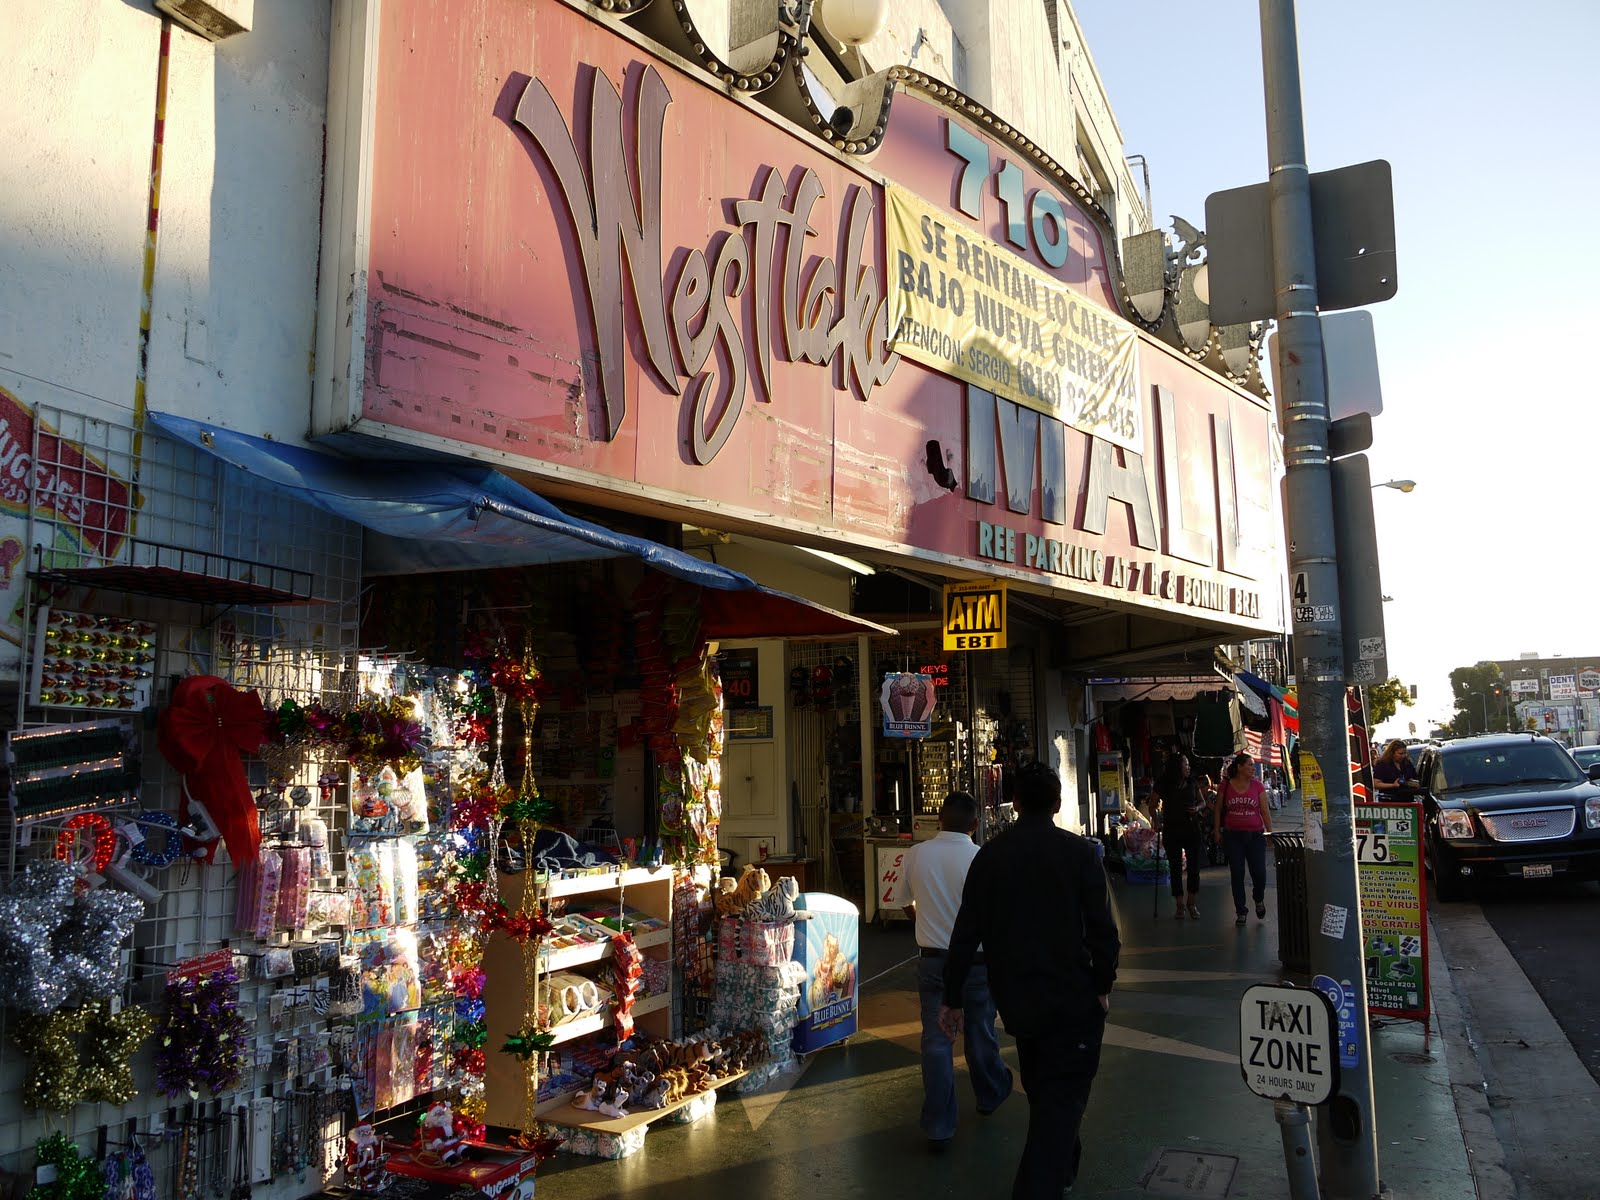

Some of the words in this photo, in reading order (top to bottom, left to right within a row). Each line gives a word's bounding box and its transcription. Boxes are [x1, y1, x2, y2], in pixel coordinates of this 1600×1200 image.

[948, 118, 1069, 269] 710
[514, 63, 899, 466] Westlake
[920, 214, 947, 263] SE
[955, 233, 1038, 312] RENTAN
[1043, 285, 1120, 356] LOCALES
[897, 248, 965, 318] BAJO
[973, 289, 1045, 359] NUEVA
[968, 346, 1011, 387] SERGIO
[1016, 355, 1062, 407] (818)
[0, 418, 91, 522] UGGIES
[967, 381, 1258, 582] MALL
[979, 520, 1016, 562] REE
[1025, 532, 1105, 582] PARKING
[1111, 555, 1132, 590] AT
[1166, 570, 1177, 599] &
[1183, 575, 1229, 612] BONNIE
[1294, 573, 1308, 604] 4
[948, 594, 1001, 630] ATM
[956, 635, 994, 649] EBT
[920, 664, 948, 674] KEYS
[1357, 835, 1388, 862] 75
[1369, 900, 1383, 908] DE
[1386, 901, 1419, 909] VIRUS
[1381, 920, 1420, 929] GRATIS
[813, 1007, 830, 1024] BLUE
[829, 1000, 851, 1018] BUNNY
[1367, 993, 1404, 1002] 13-7984
[1367, 1000, 1404, 1009] 95-8201
[1256, 1000, 1313, 1036] TAXI
[1249, 1036, 1323, 1076] ZONE
[1256, 1074, 1266, 1084] 24
[1268, 1076, 1293, 1089] HOURS
[1296, 1080, 1316, 1093] DAILY
[482, 1173, 520, 1198] HUGGIES
